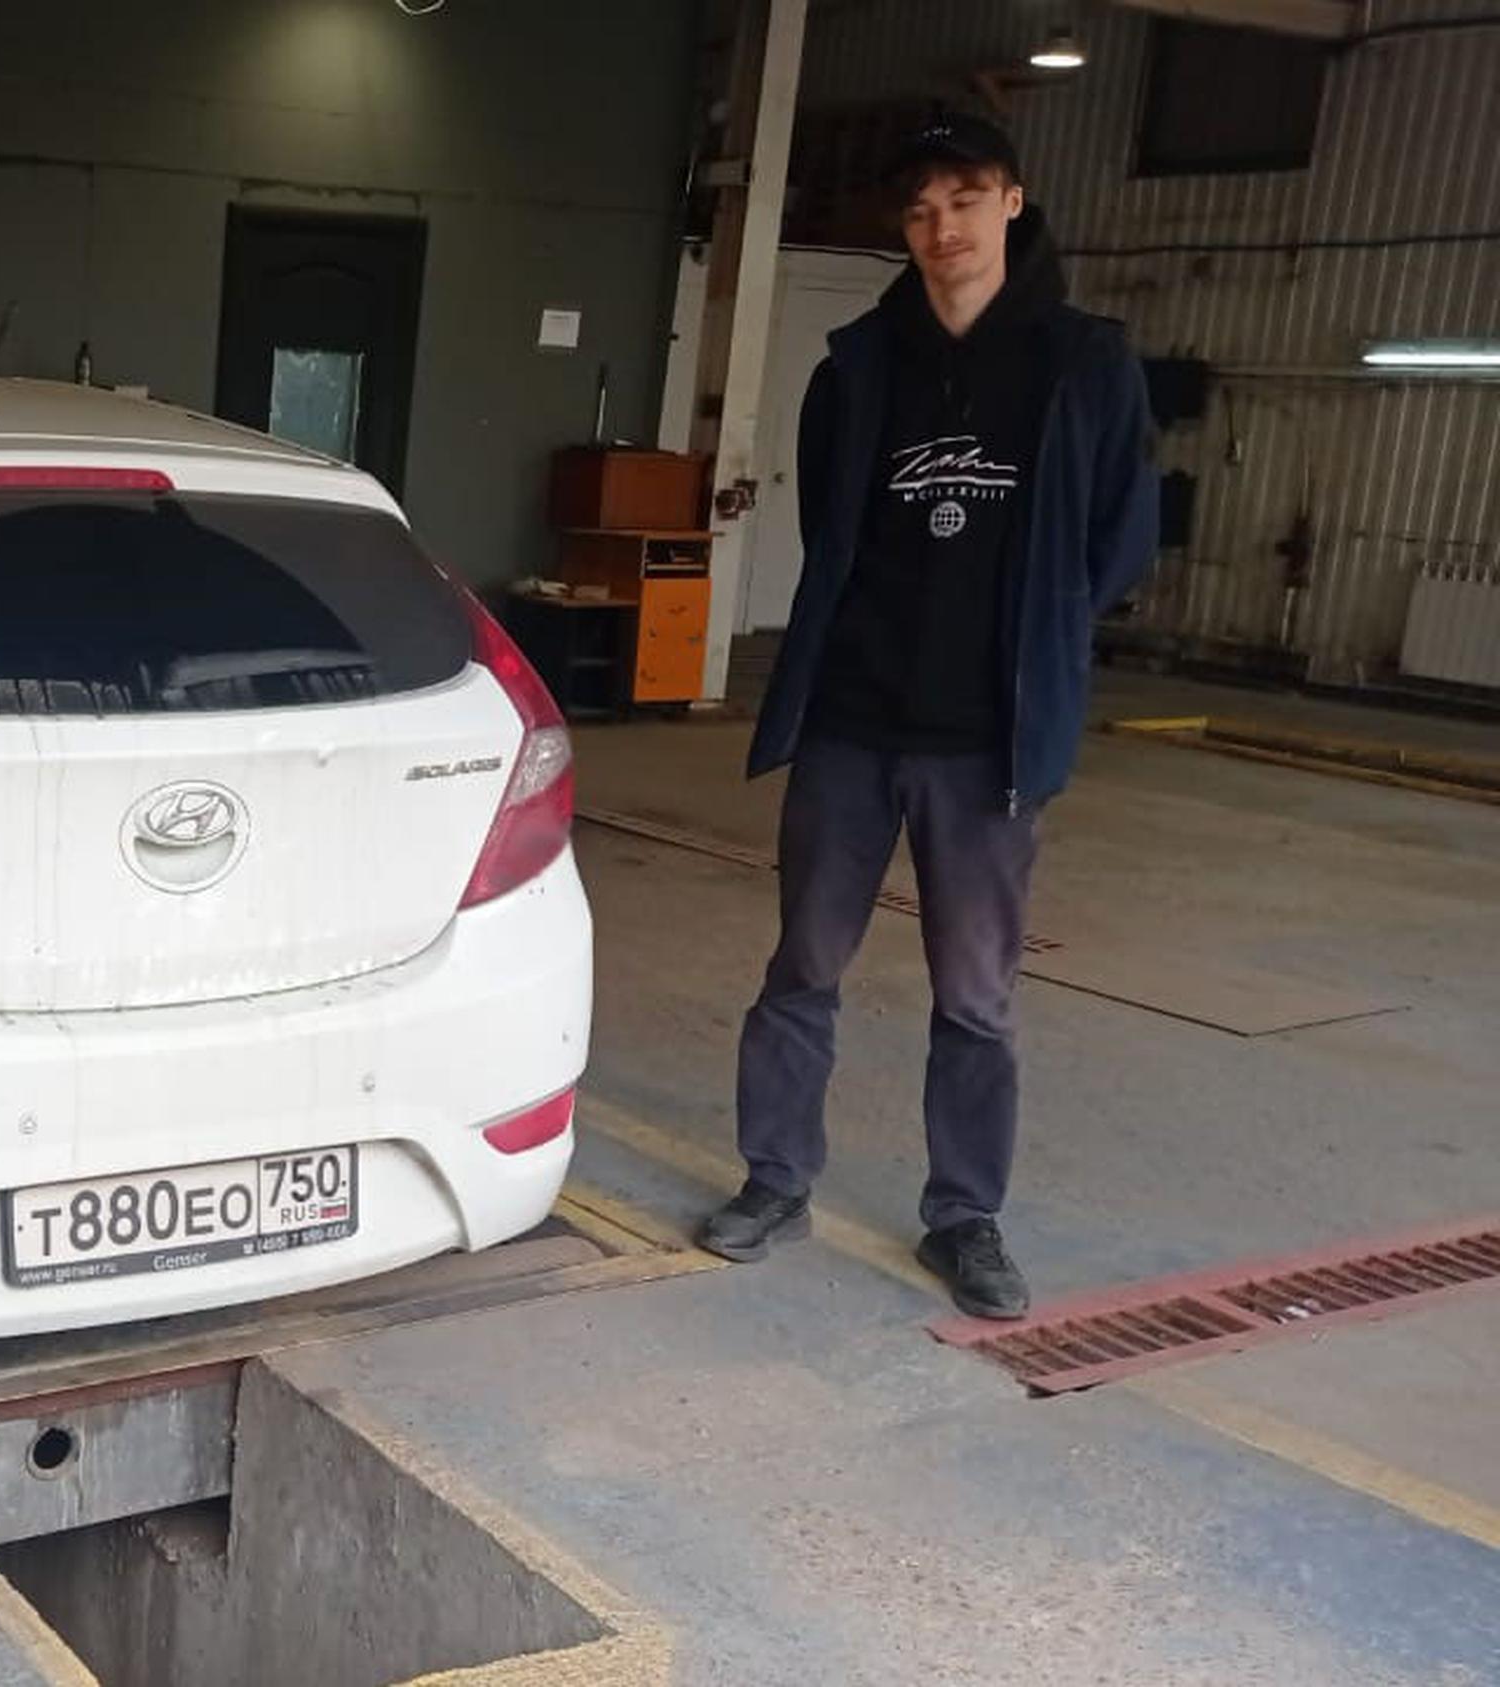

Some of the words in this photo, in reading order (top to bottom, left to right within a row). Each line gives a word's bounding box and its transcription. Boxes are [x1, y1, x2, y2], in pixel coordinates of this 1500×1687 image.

[263, 1154, 342, 1208] 750
[280, 1204, 319, 1225] RUS
[153, 1250, 208, 1271] Genser
